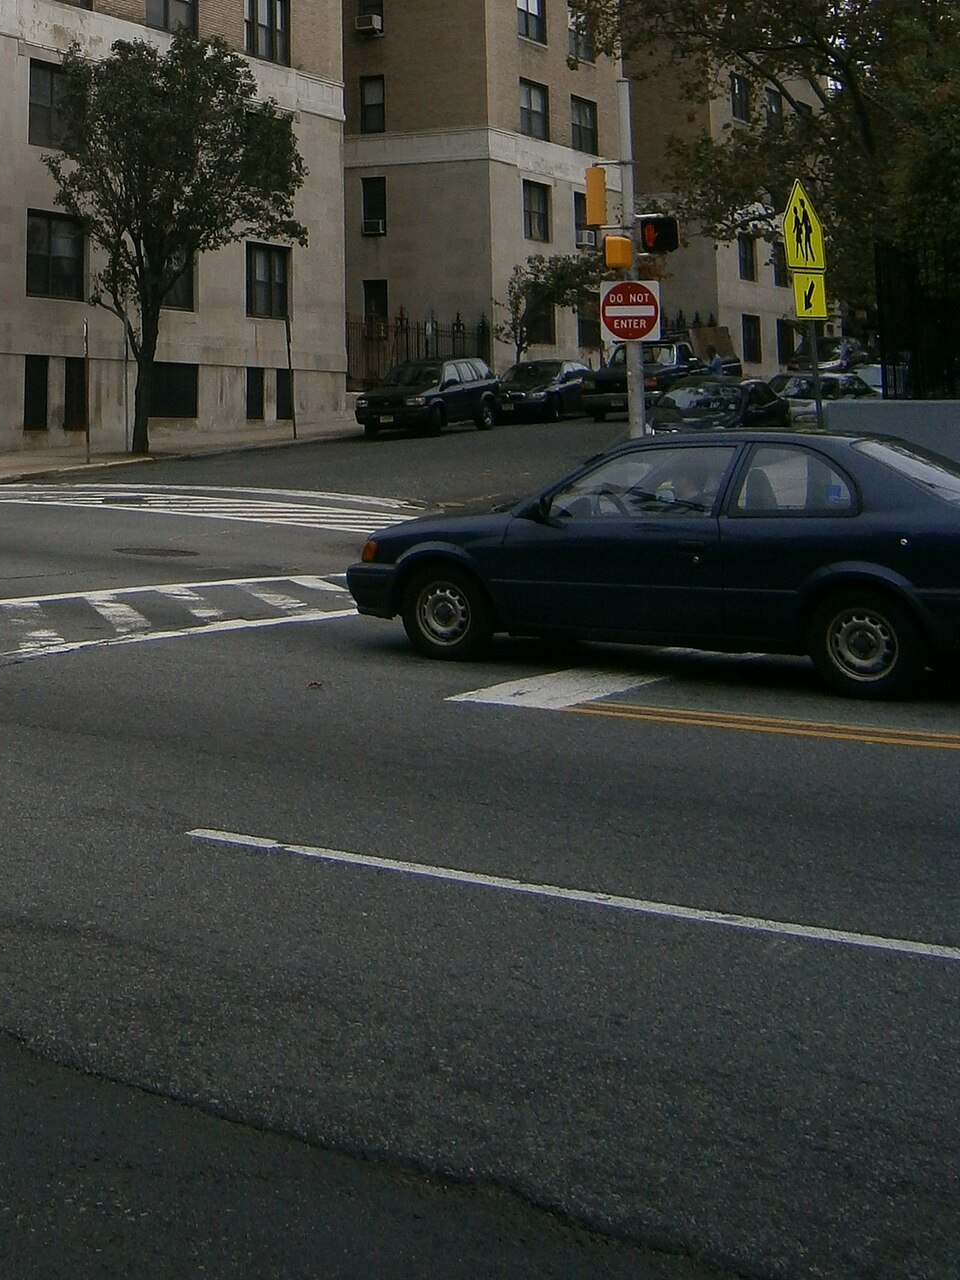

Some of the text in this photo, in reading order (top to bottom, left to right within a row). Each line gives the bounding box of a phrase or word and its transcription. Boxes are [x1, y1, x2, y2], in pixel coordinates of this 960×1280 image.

[609, 293, 649, 303] DO NOT
[613, 319, 647, 329] ENTER
